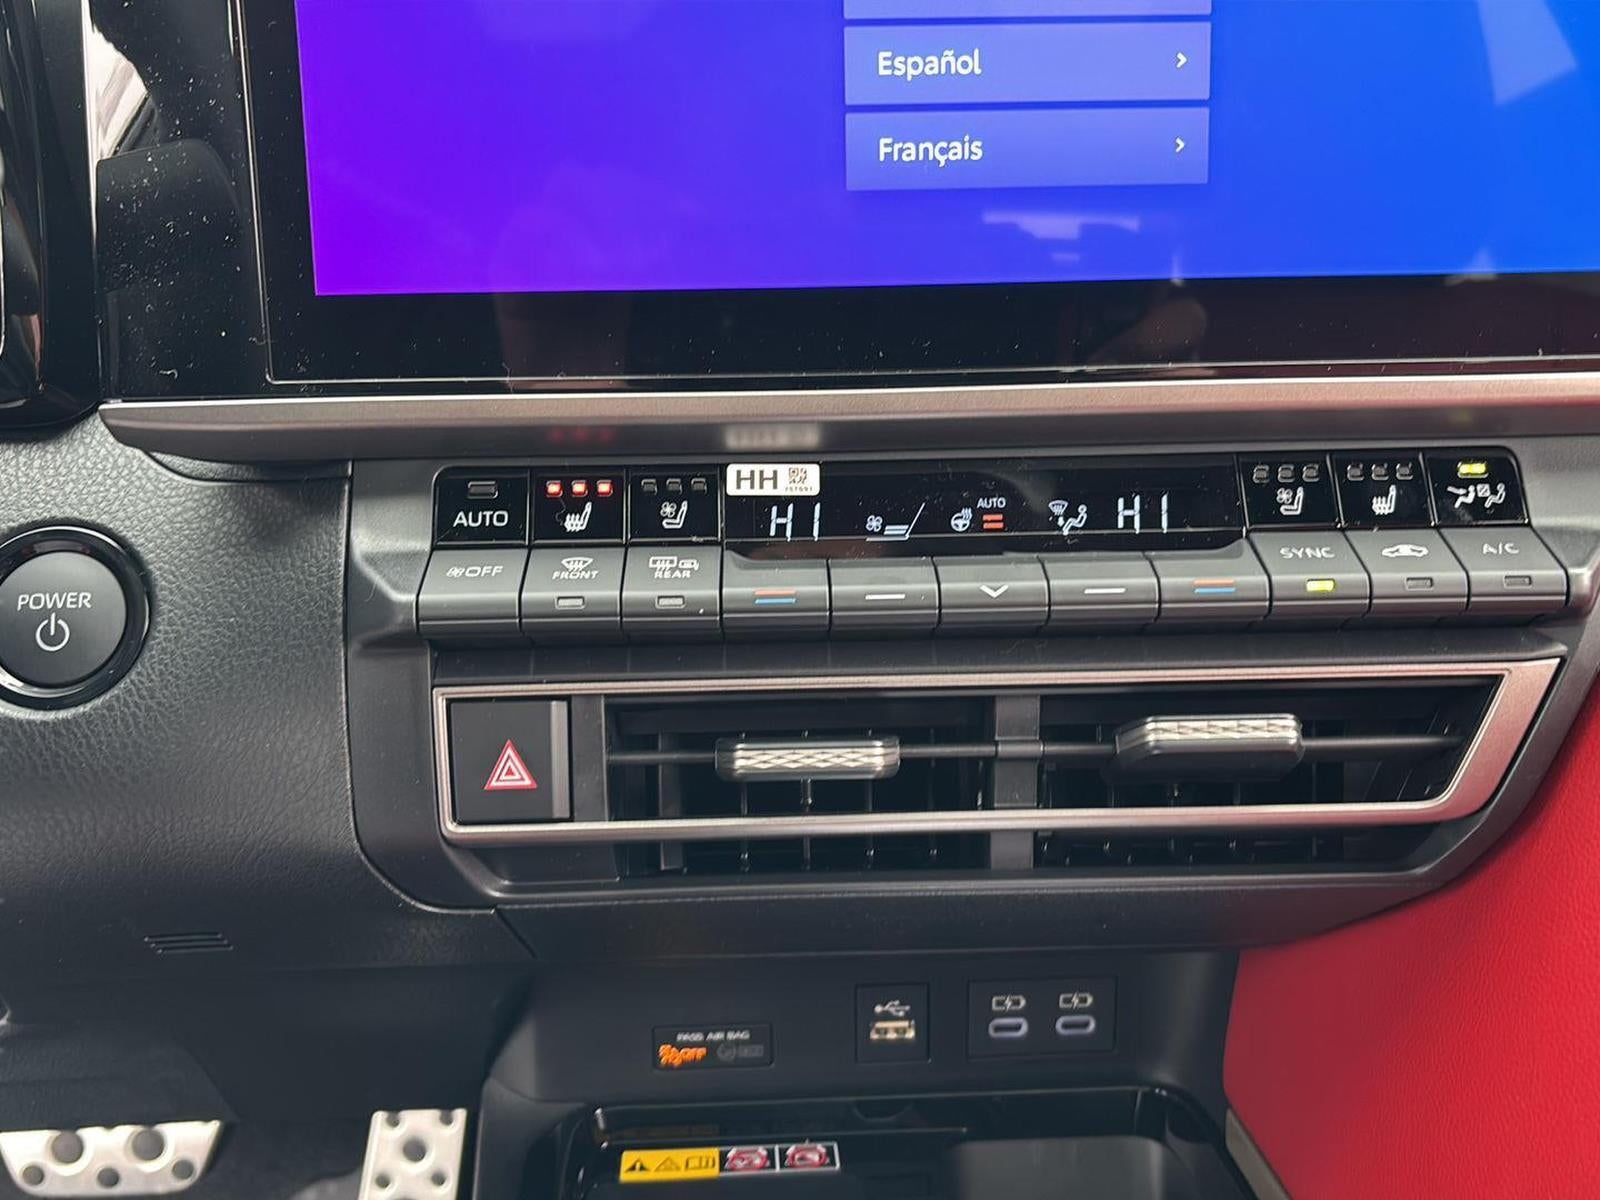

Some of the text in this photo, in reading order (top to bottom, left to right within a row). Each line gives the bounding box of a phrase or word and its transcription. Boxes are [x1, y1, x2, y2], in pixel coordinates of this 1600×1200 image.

[878, 48, 982, 81] Español
[879, 134, 983, 167] Français
[736, 469, 778, 490] HH
[977, 497, 1007, 508] AUTO
[453, 511, 509, 527] AUTO
[1279, 546, 1336, 559] SYNC
[1482, 542, 1520, 555] A/C
[465, 566, 503, 577] OFF
[552, 570, 598, 580] FRONT
[654, 569, 692, 579] REAR
[17, 592, 92, 611] POWER
[726, 1030, 750, 1040] BAG
